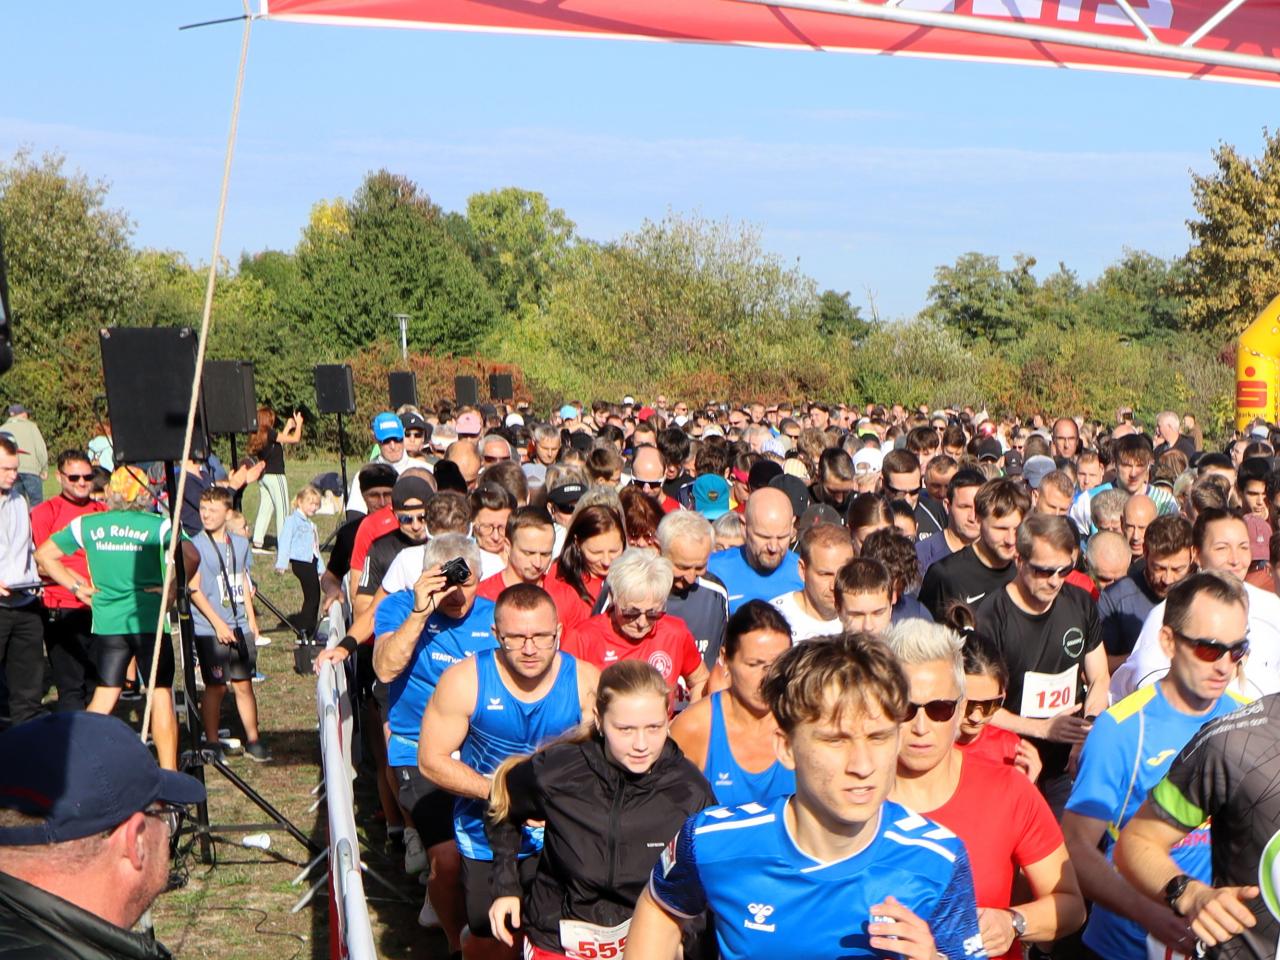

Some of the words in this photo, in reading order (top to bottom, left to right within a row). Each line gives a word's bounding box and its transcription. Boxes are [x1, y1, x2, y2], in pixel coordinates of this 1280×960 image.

[90, 527, 105, 541] LG
[110, 525, 149, 543] Roland
[1036, 686, 1071, 709] 120
